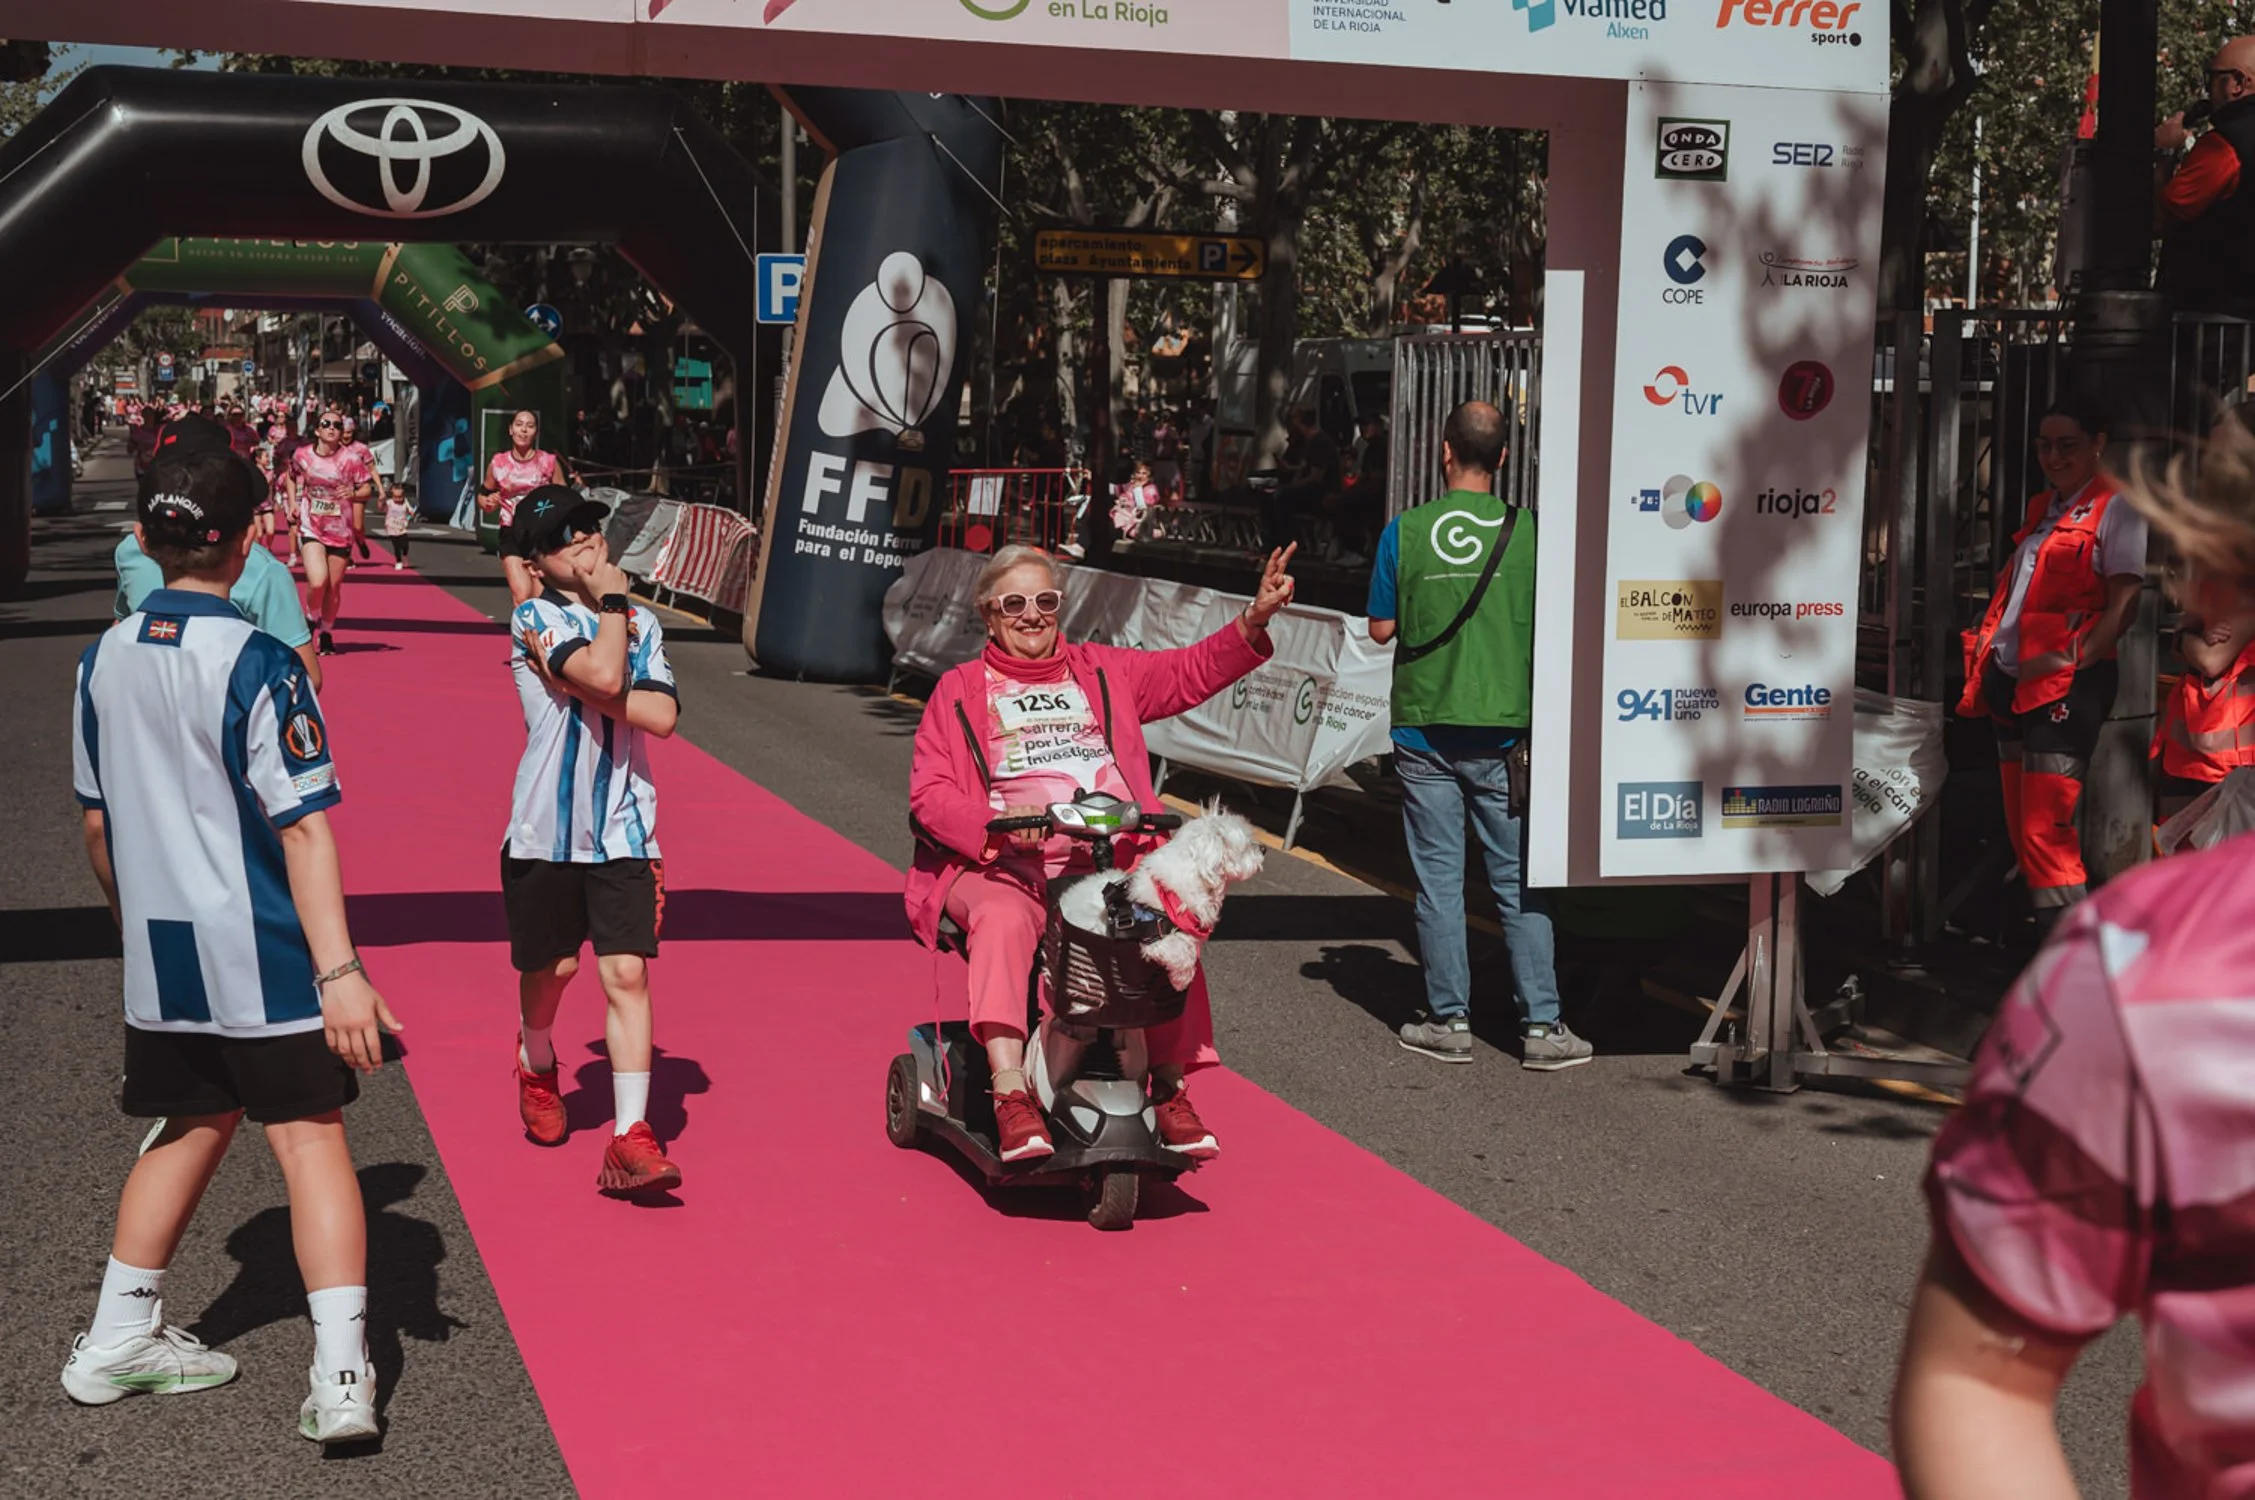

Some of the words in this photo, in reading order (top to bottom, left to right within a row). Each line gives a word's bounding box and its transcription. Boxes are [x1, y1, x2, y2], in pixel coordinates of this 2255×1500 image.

[1048, 2, 1075, 17] en
[1082, 0, 1107, 19] La
[1115, 1, 1168, 27] Rioja
[1313, 5, 1406, 21] INTERNACIONAL
[1313, 18, 1328, 29] DE
[1331, 20, 1346, 30] LA
[1349, 21, 1381, 32] RIOJA
[1606, 22, 1649, 40] Alxen
[1810, 32, 1848, 45] sport
[1668, 132, 1717, 145] ONDA
[1670, 153, 1716, 168] CERO
[1772, 142, 1834, 167] SER
[1039, 237, 1143, 252] aparcamiento
[1039, 253, 1079, 266] plaza
[1089, 255, 1192, 270] Ayuntamiento
[771, 262, 804, 315] P
[1783, 274, 1802, 287] LA
[1805, 274, 1848, 289] RIOJA
[1662, 288, 1704, 305] COPE
[394, 271, 488, 370] PITILLOS
[1681, 387, 1724, 415] tvr
[802, 450, 933, 528] FFD
[1757, 488, 1837, 519] rioja2
[798, 518, 879, 547] Fundación
[795, 539, 831, 557] para
[839, 546, 856, 561] el
[863, 549, 905, 569] Depo
[1620, 597, 1629, 608] EL
[1630, 588, 1694, 607] BALCÓN
[1662, 612, 1672, 622] DE
[1672, 607, 1717, 624] MATEO
[1730, 602, 1792, 620] europa
[1796, 601, 1845, 620] press
[1013, 693, 1071, 713] 1256
[1674, 698, 1720, 710] cuatro
[1744, 683, 1832, 707] Gente
[1616, 689, 1673, 722] 941
[1675, 688, 1718, 699] nueve
[1675, 709, 1701, 721] uno
[1024, 739, 1051, 754] por
[1027, 746, 1110, 766] Investigaci
[1868, 778, 1889, 790] el
[1625, 791, 1648, 821] El
[1653, 793, 1697, 821] Día
[1758, 798, 1790, 814] RADIO
[1792, 793, 1840, 813] LOGROÑO
[1650, 821, 1663, 831] de
[1664, 821, 1674, 830] La
